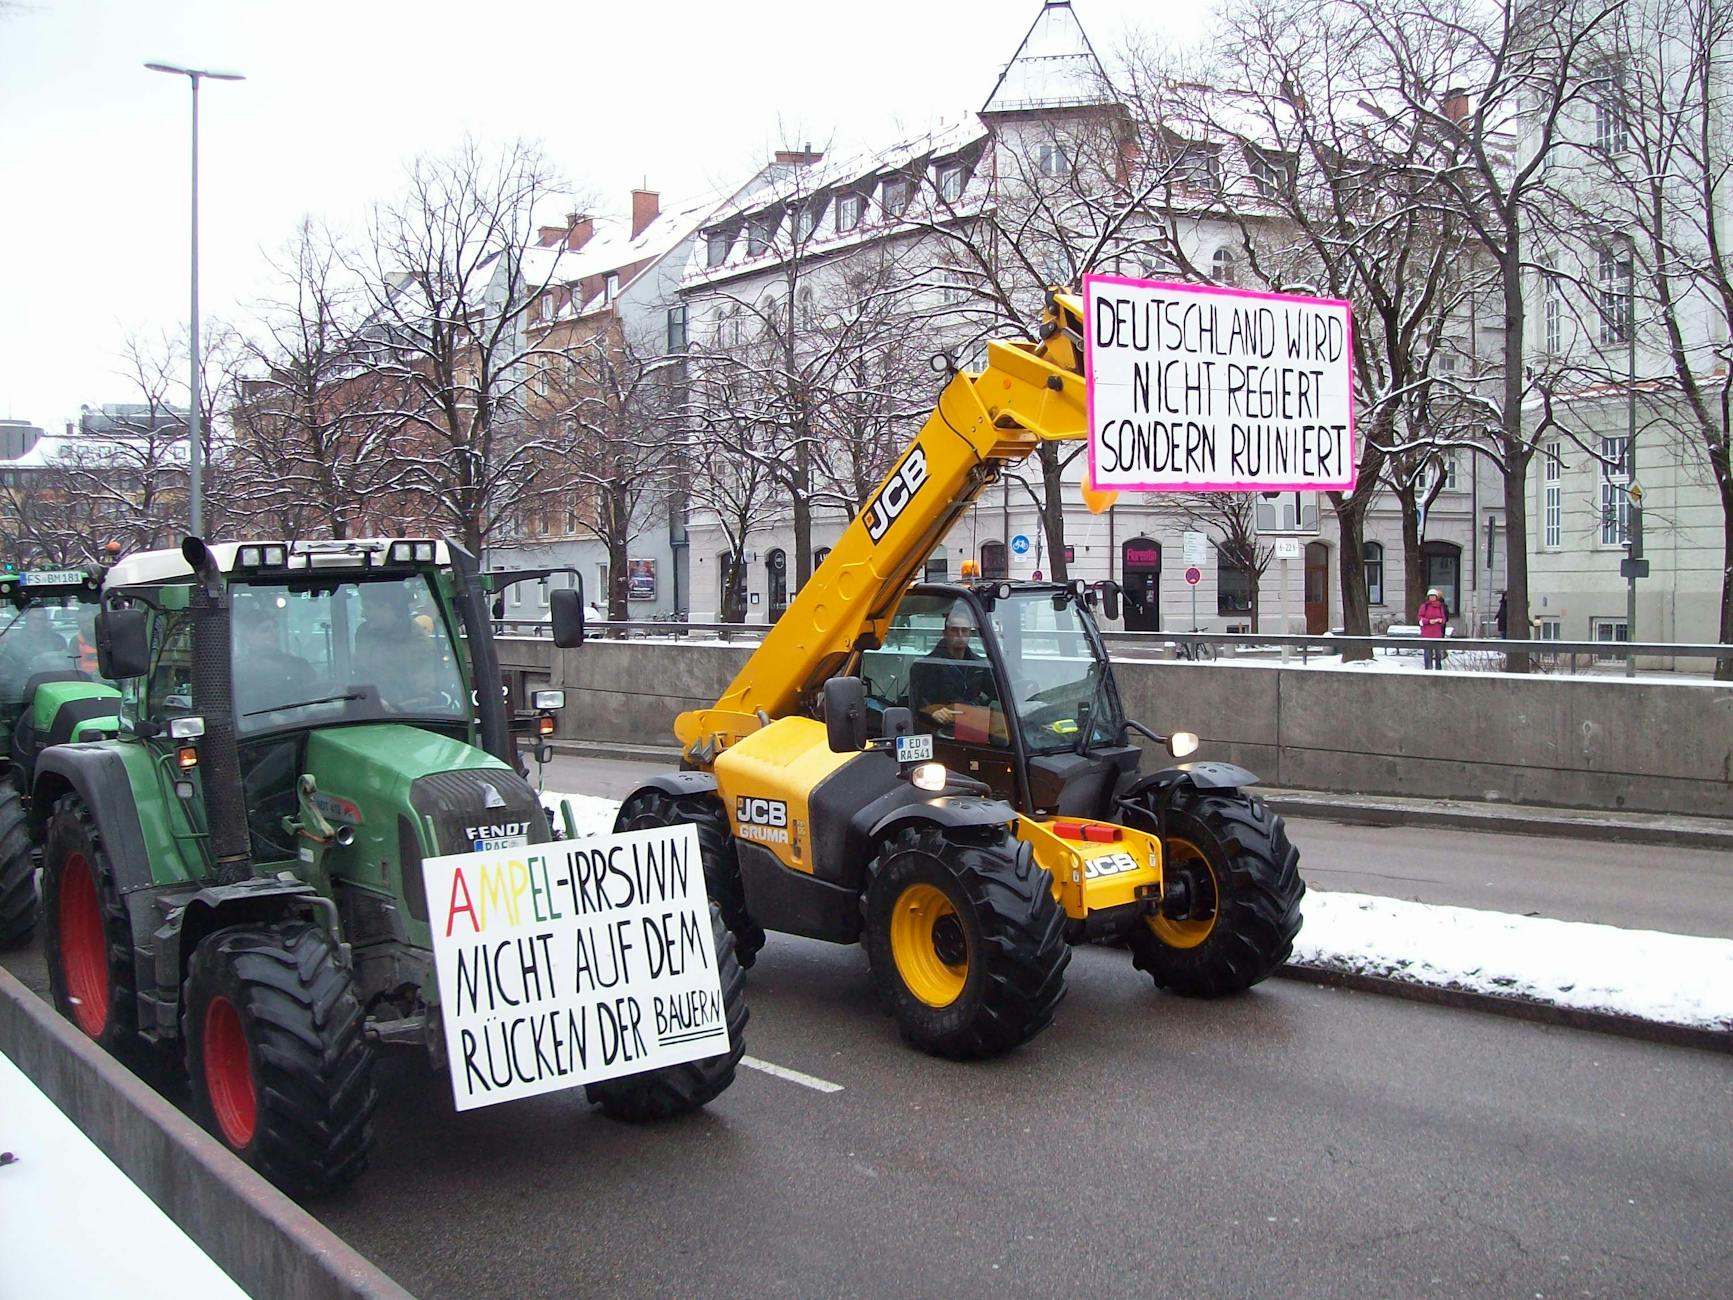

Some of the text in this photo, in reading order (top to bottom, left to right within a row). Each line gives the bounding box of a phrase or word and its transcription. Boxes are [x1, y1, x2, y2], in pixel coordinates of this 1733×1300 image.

[1096, 296, 1343, 363] DEUTSCHLAND WIRD
[1133, 360, 1323, 419] NICHT REGIERT
[1100, 419, 1346, 477] SONDERN RUINIERT
[869, 449, 928, 540] JCB
[28, 574, 41, 584] FS
[909, 738, 921, 748] ED
[465, 821, 531, 840] FENDT
[737, 798, 787, 827] JCB
[740, 824, 789, 844] GRUMA
[445, 836, 688, 938] AMPEL-IRRSINN
[1084, 853, 1138, 879] JCB
[456, 909, 708, 1017] NICHT AUF DEM
[460, 989, 721, 1095] RÜCKEN DER BAUERN
